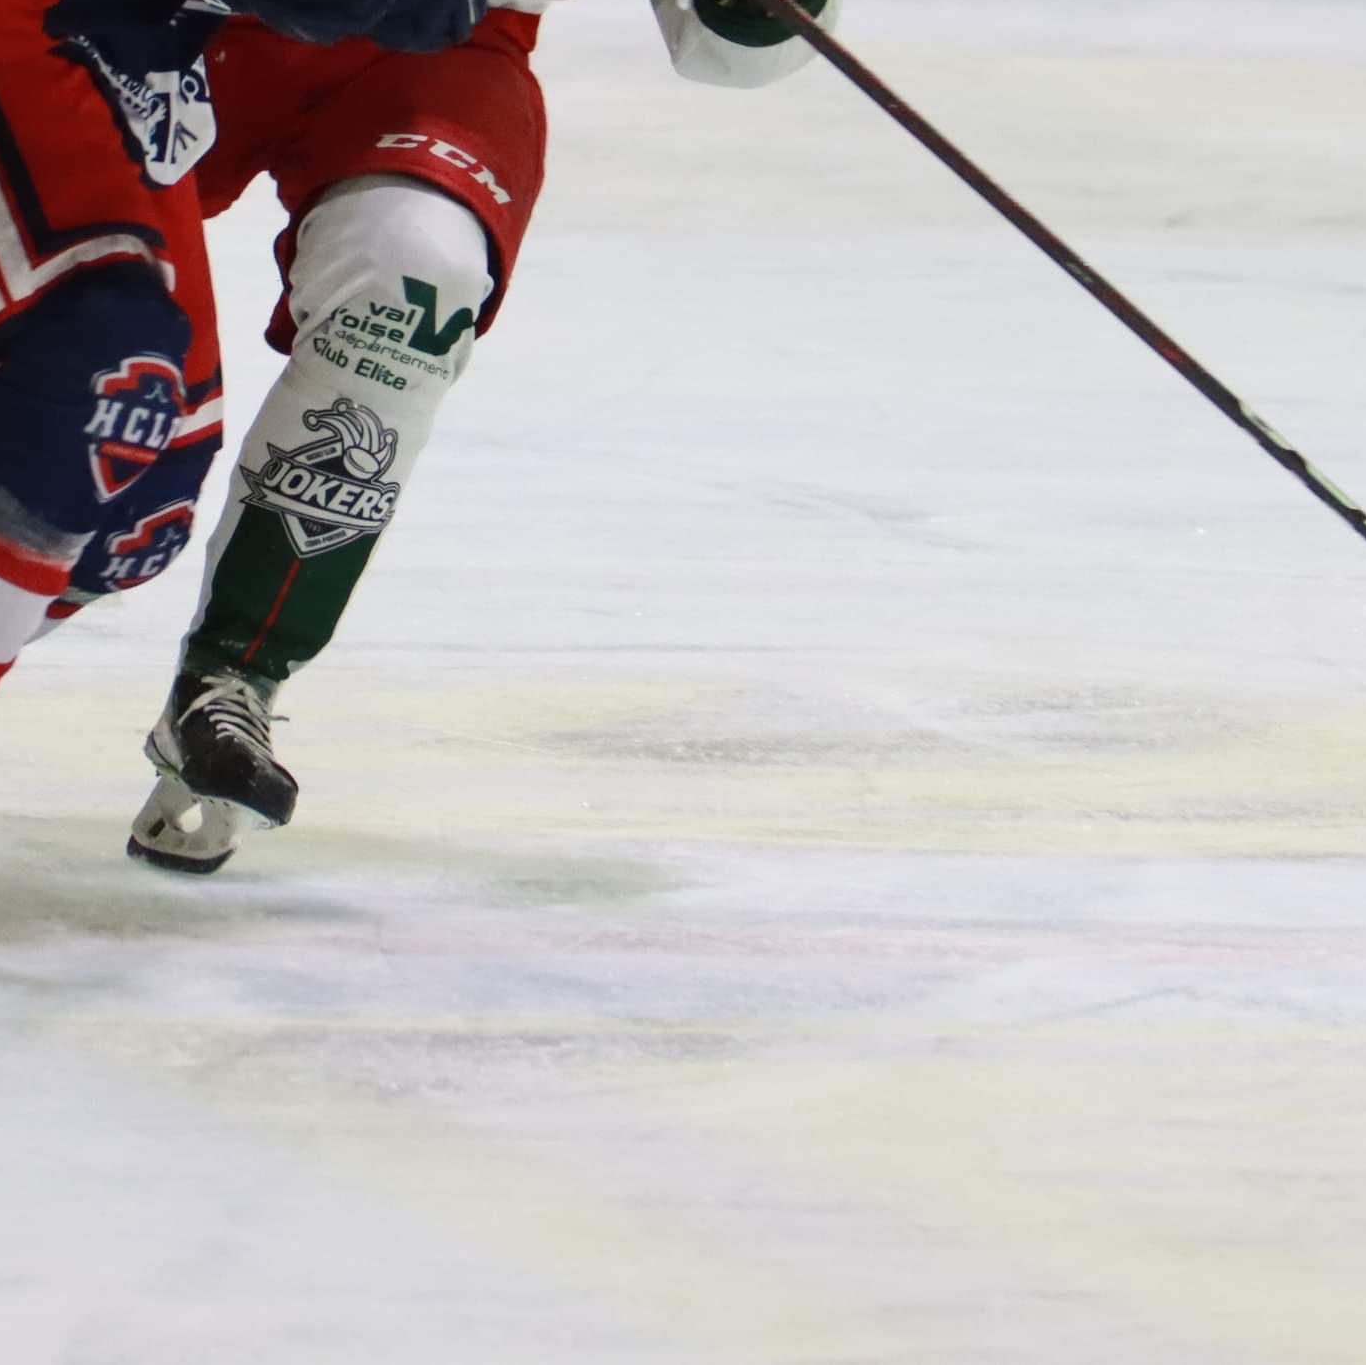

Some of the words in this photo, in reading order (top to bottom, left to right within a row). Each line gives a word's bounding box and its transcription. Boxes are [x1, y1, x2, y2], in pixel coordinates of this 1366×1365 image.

[375, 132, 513, 205] CCM
[369, 301, 417, 327] val
[312, 337, 349, 369] Club
[354, 358, 408, 391] Elite
[262, 456, 398, 522] JOKERS
